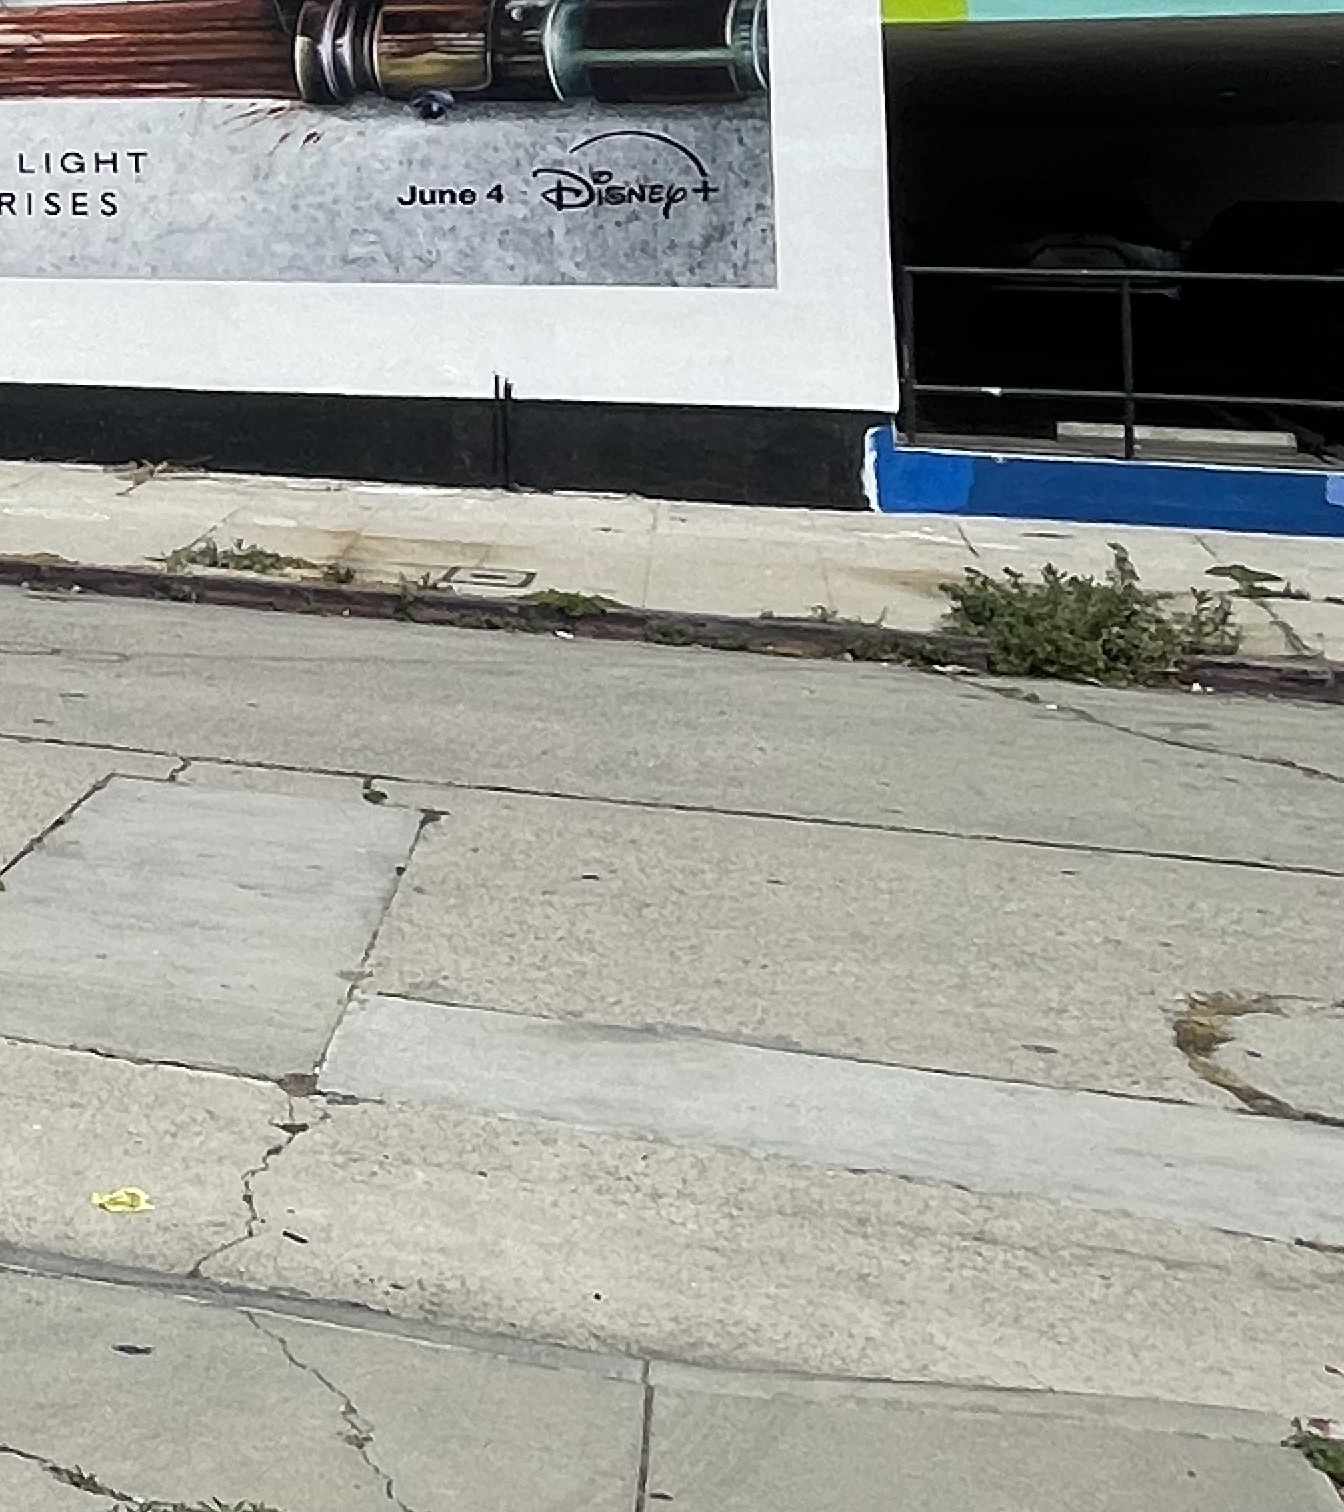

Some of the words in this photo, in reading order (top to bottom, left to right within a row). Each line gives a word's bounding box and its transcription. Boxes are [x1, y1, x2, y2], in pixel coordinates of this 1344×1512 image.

[18, 151, 149, 175] LIGHT
[396, 184, 477, 207] June
[485, 183, 505, 204] 4
